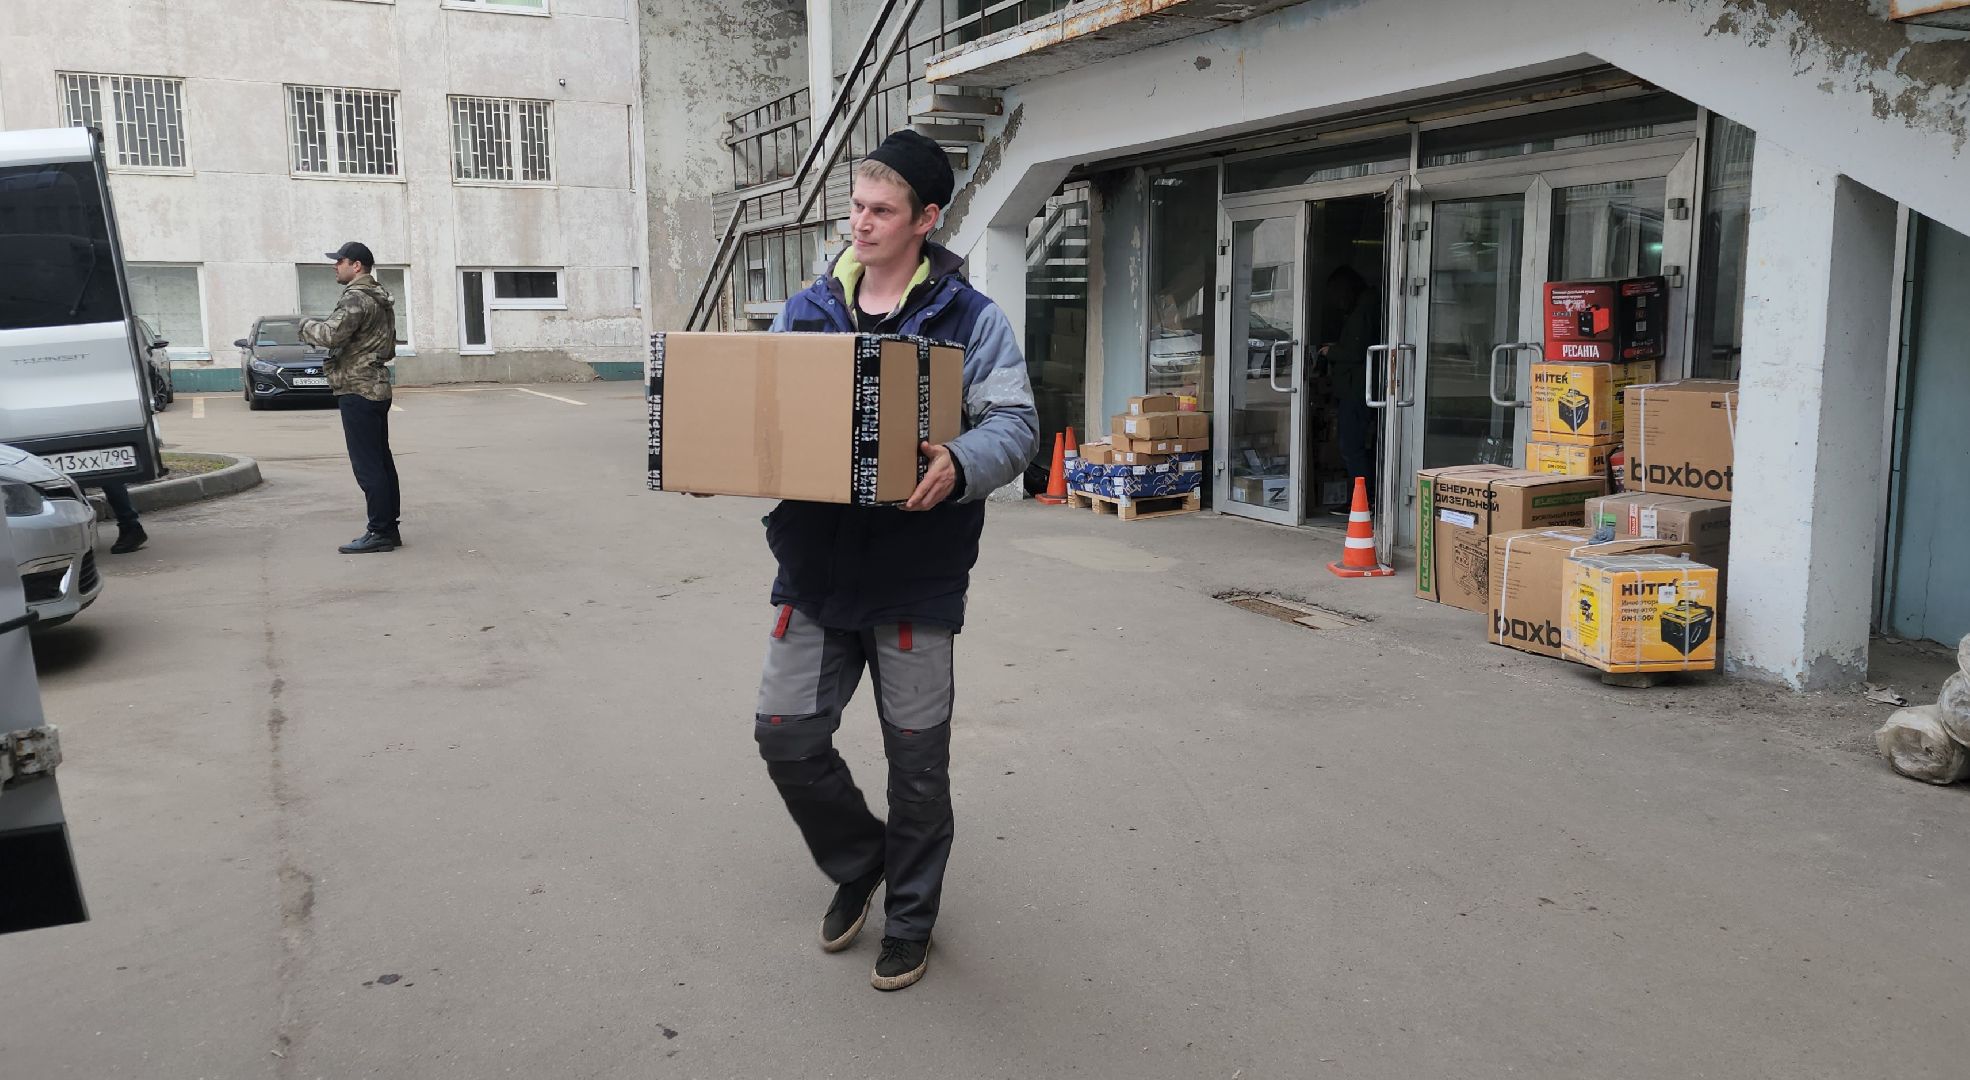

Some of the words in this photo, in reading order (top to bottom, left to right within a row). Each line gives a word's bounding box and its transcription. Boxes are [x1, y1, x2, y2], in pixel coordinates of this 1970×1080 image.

[10, 352, 89, 366] TRANSIT
[1562, 344, 1600, 358] РЕСАНТА
[652, 394, 661, 447] ПАРНЕЙ
[861, 386, 870, 442] ПАРНЕЙ
[869, 386, 879, 441] КРУТЫХ
[43, 455, 101, 471] 13ХХ
[102, 449, 129, 462] 790
[1631, 457, 1733, 491] boxbot
[1421, 487, 1430, 588] ELECTROLITE
[1494, 609, 1562, 648] boxb
